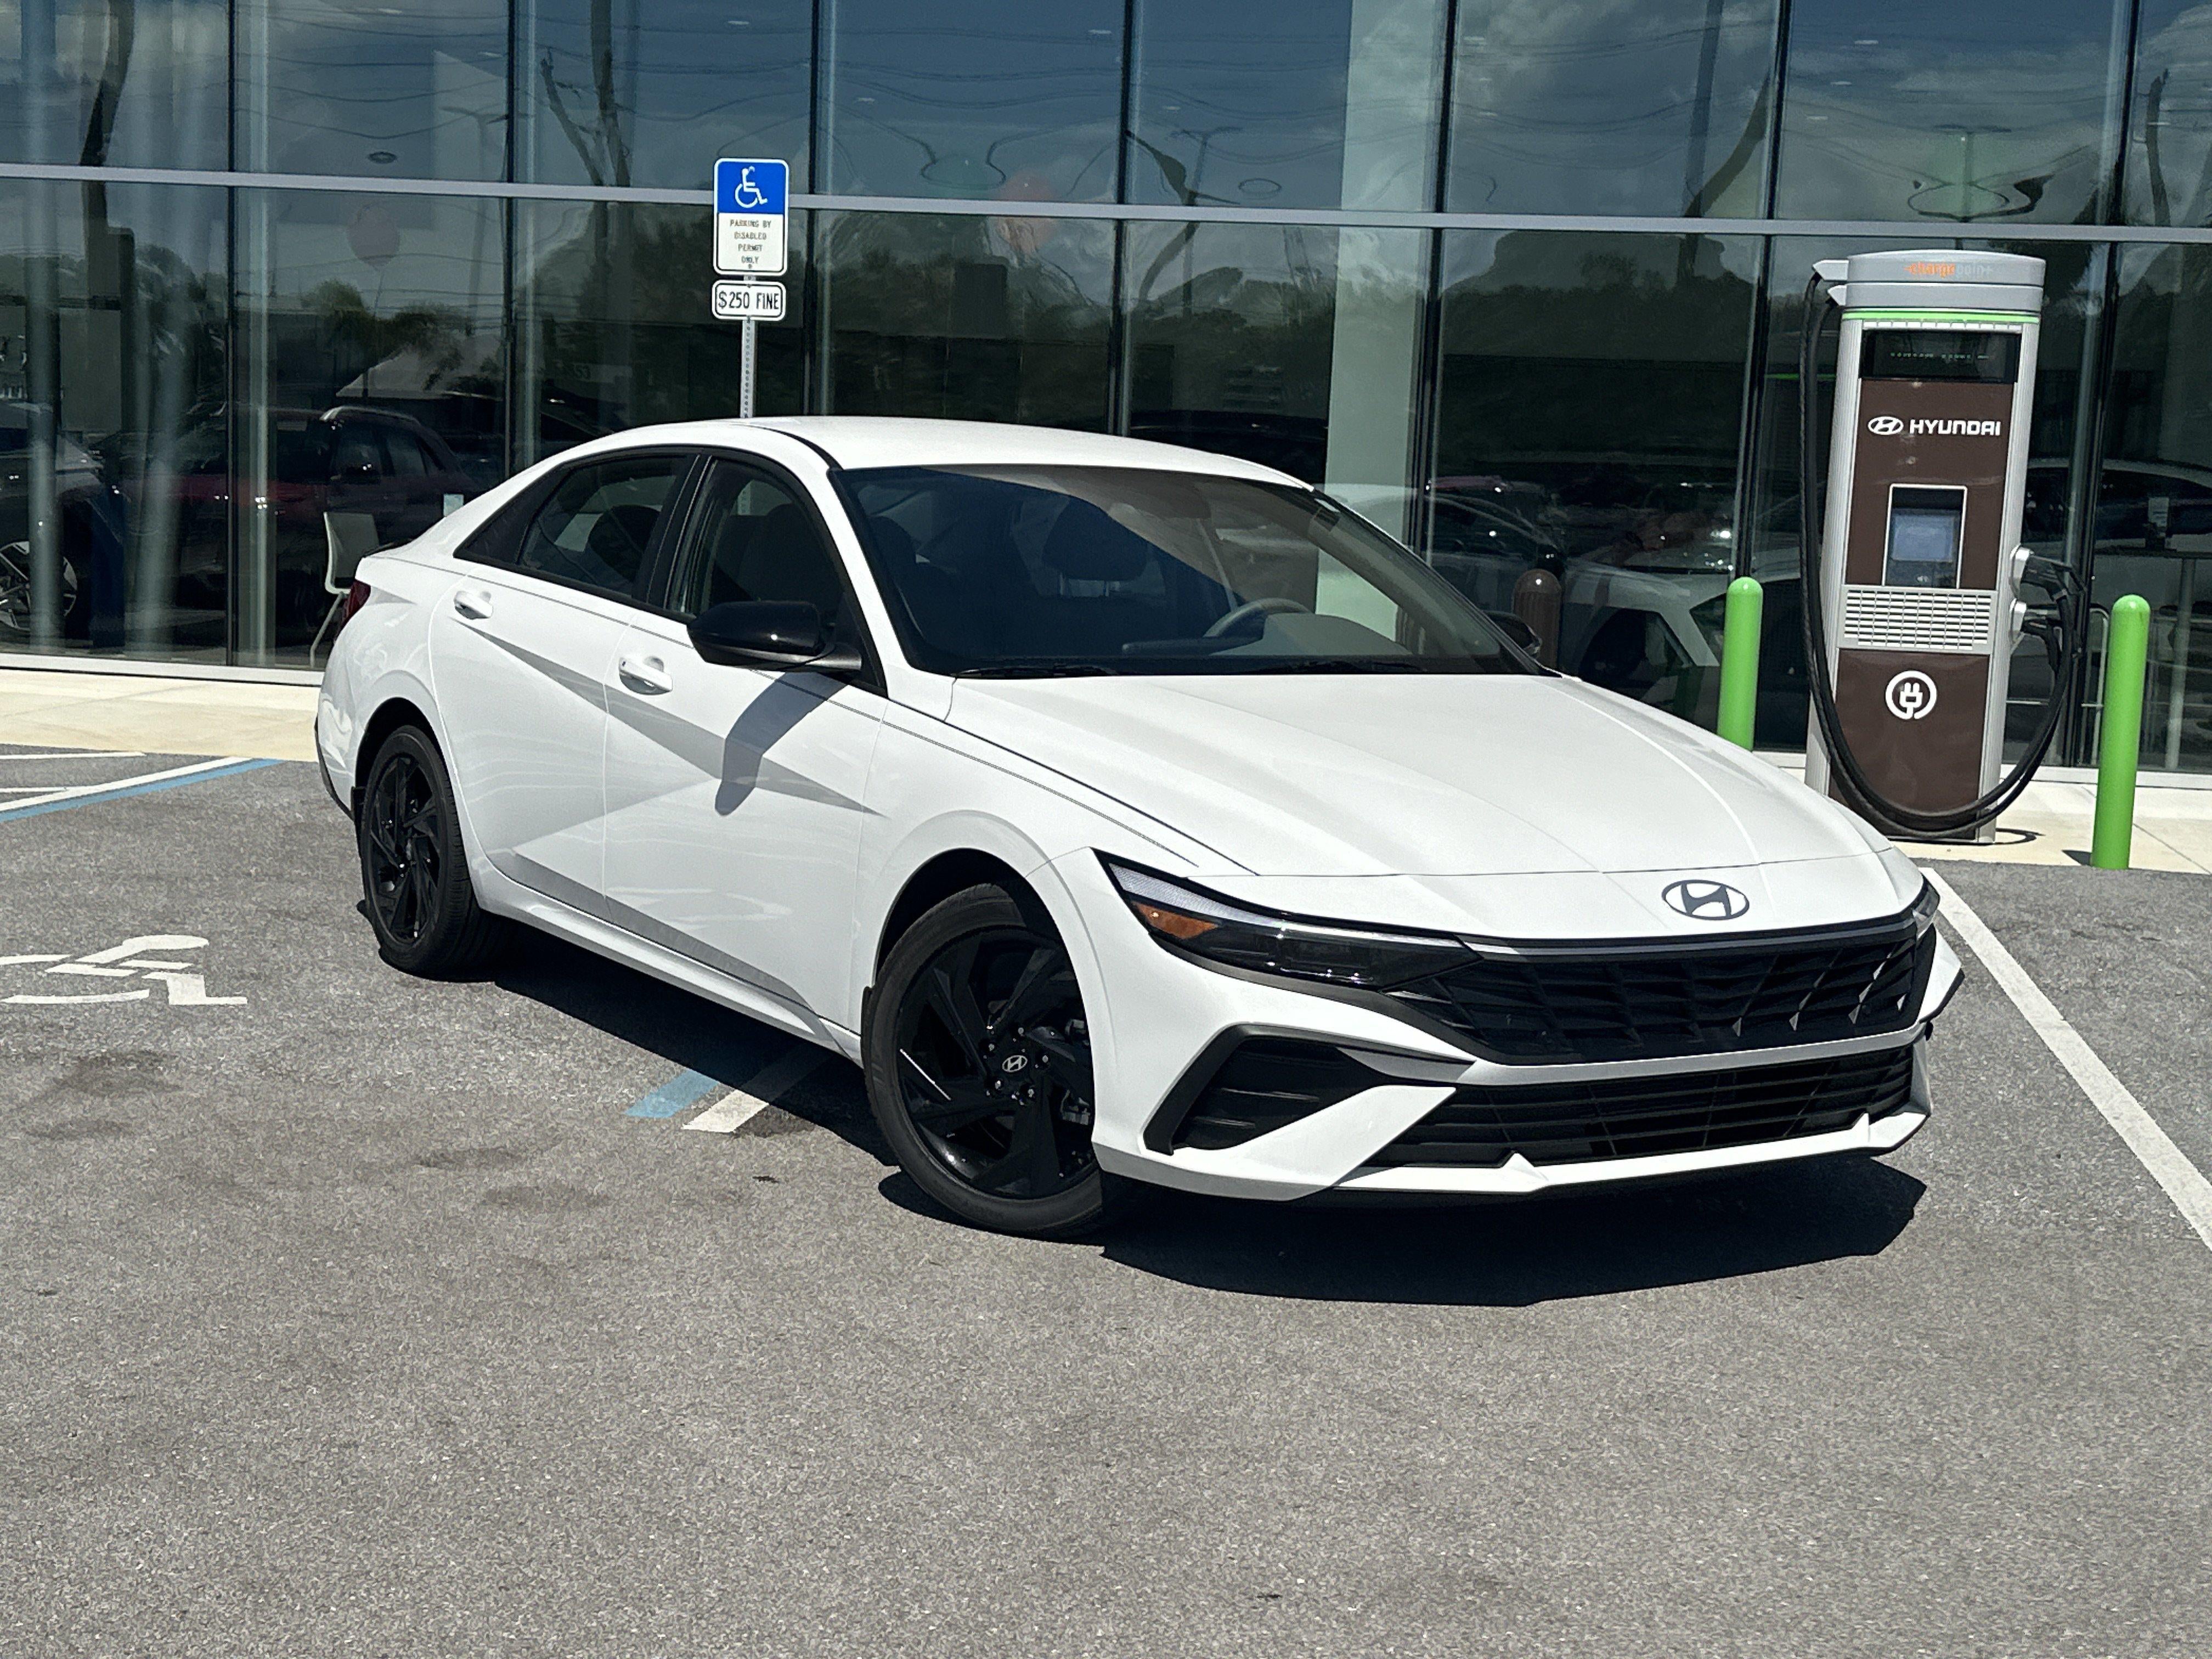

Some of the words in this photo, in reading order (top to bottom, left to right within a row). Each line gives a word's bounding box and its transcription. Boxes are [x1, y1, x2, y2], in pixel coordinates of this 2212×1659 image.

[763, 220, 771, 228] BY
[718, 290, 750, 309] $250
[756, 292, 779, 309] FINE
[1909, 419, 2001, 436] HYUNDAI
